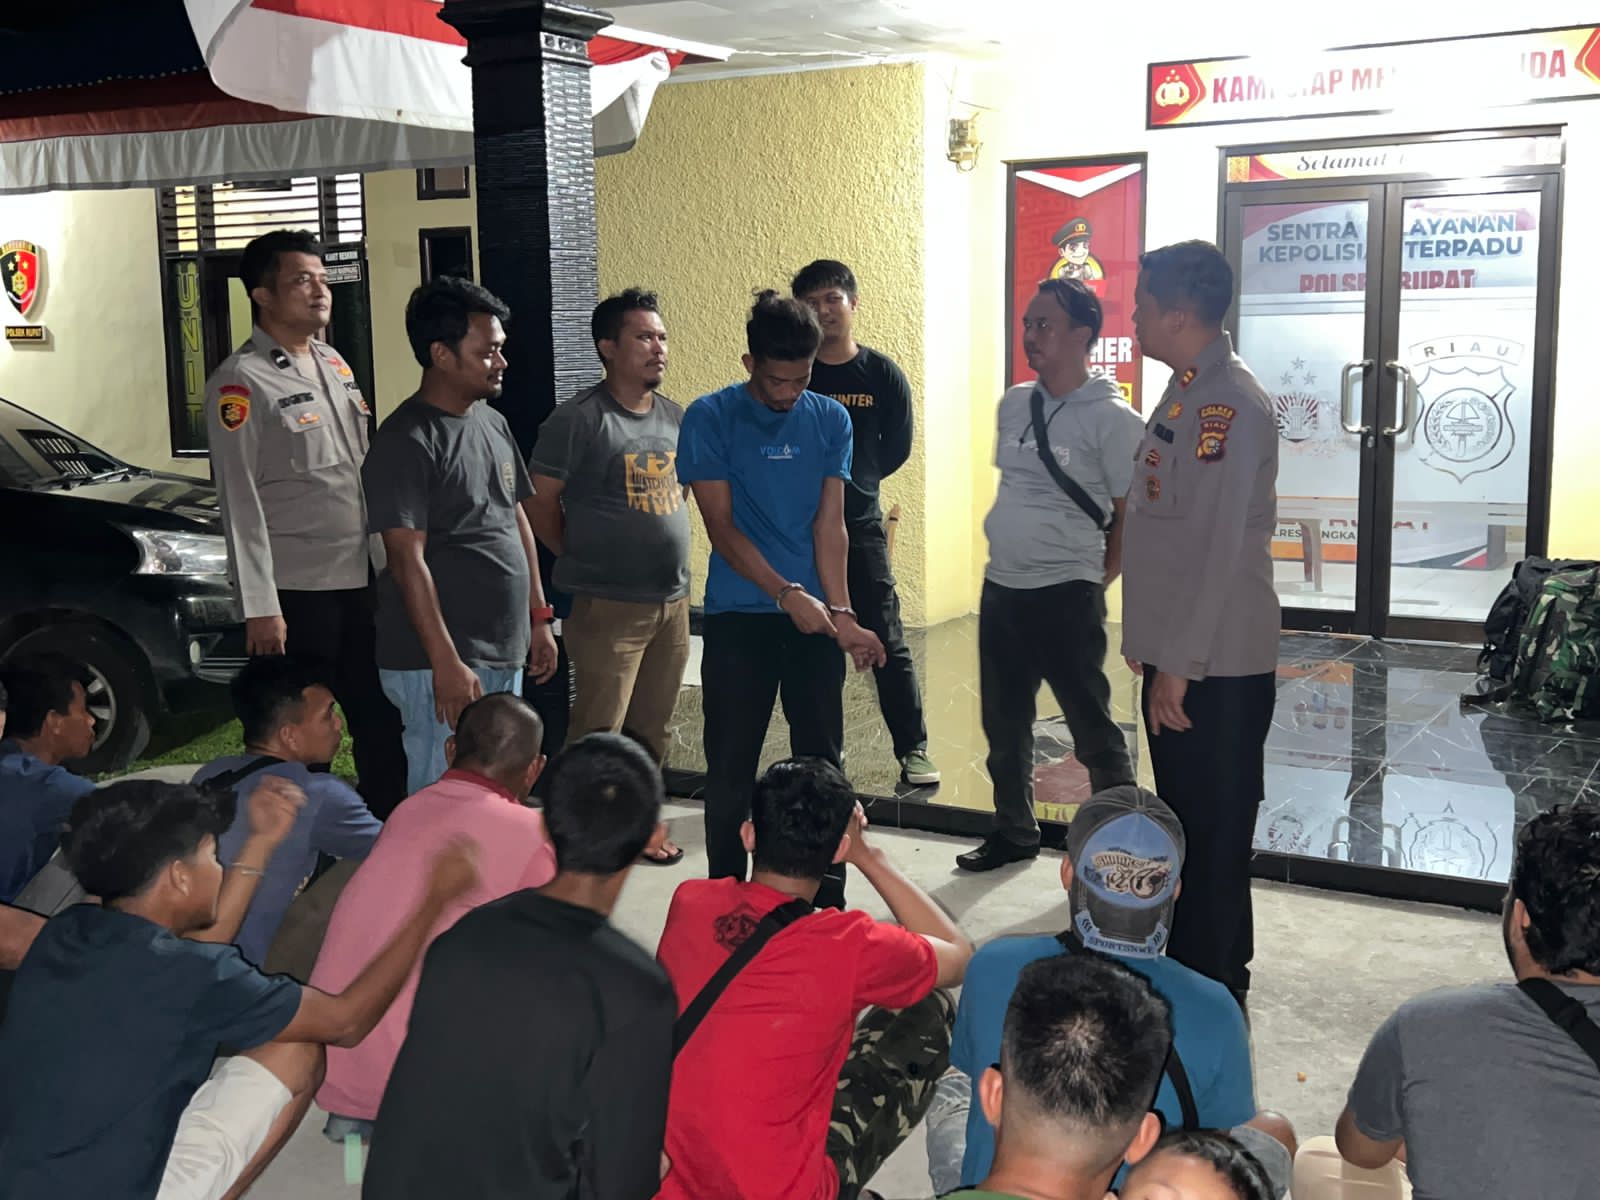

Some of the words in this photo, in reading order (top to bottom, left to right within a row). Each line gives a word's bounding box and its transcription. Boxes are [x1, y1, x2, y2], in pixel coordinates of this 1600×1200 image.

[1267, 221, 1359, 241] SENTRA
[1403, 214, 1516, 236] AYANAN
[1405, 237, 1523, 258] TERPADU
[1424, 342, 1509, 357] RIAU
